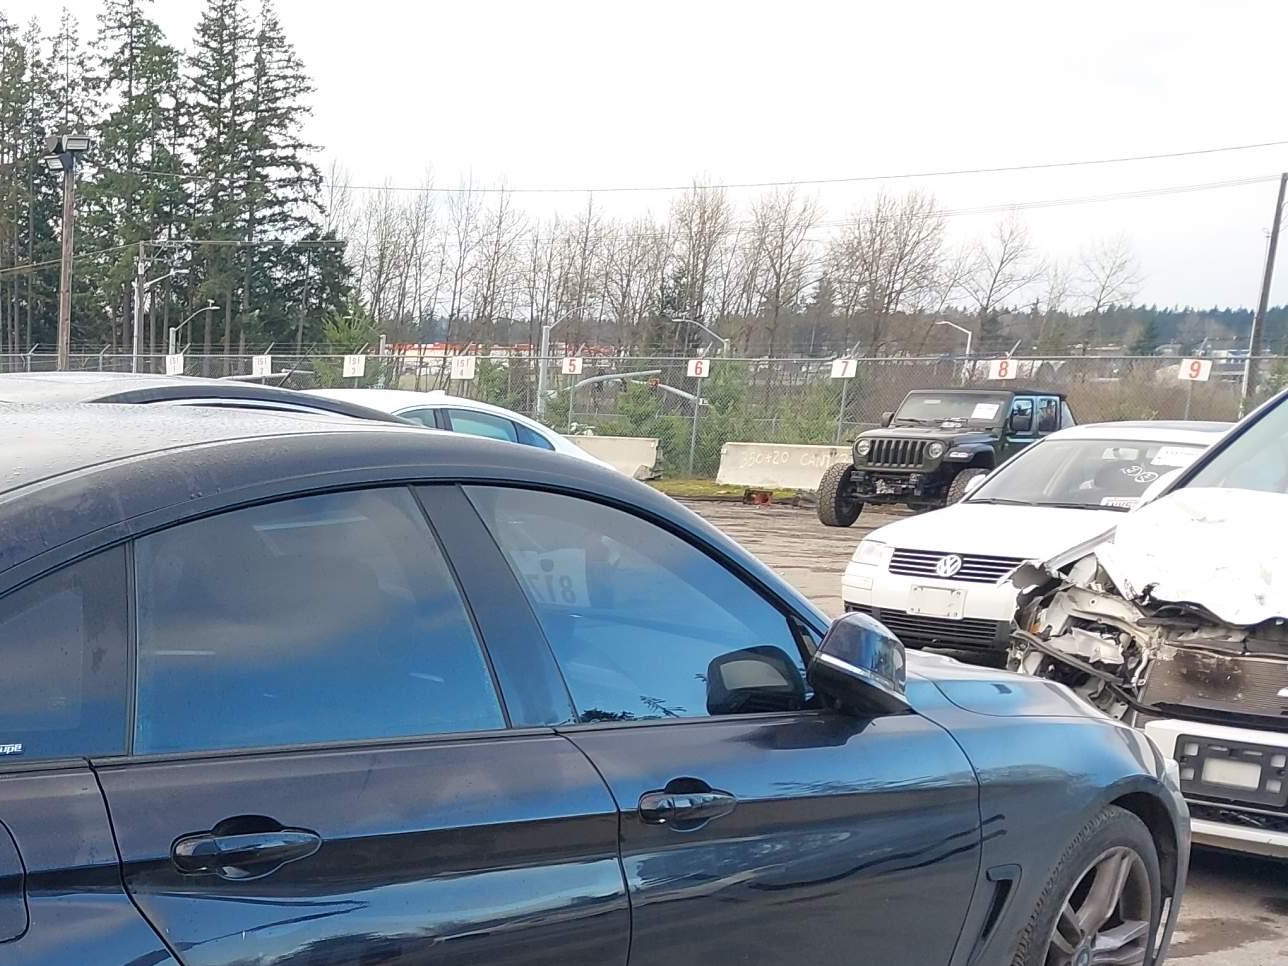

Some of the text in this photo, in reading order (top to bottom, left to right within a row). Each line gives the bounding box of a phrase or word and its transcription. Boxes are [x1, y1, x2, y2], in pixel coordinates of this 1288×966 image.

[568, 358, 576, 373] 5
[694, 360, 703, 375] 6
[841, 360, 849, 377] 7
[998, 360, 1008, 378] 8
[1189, 360, 1201, 379] 9
